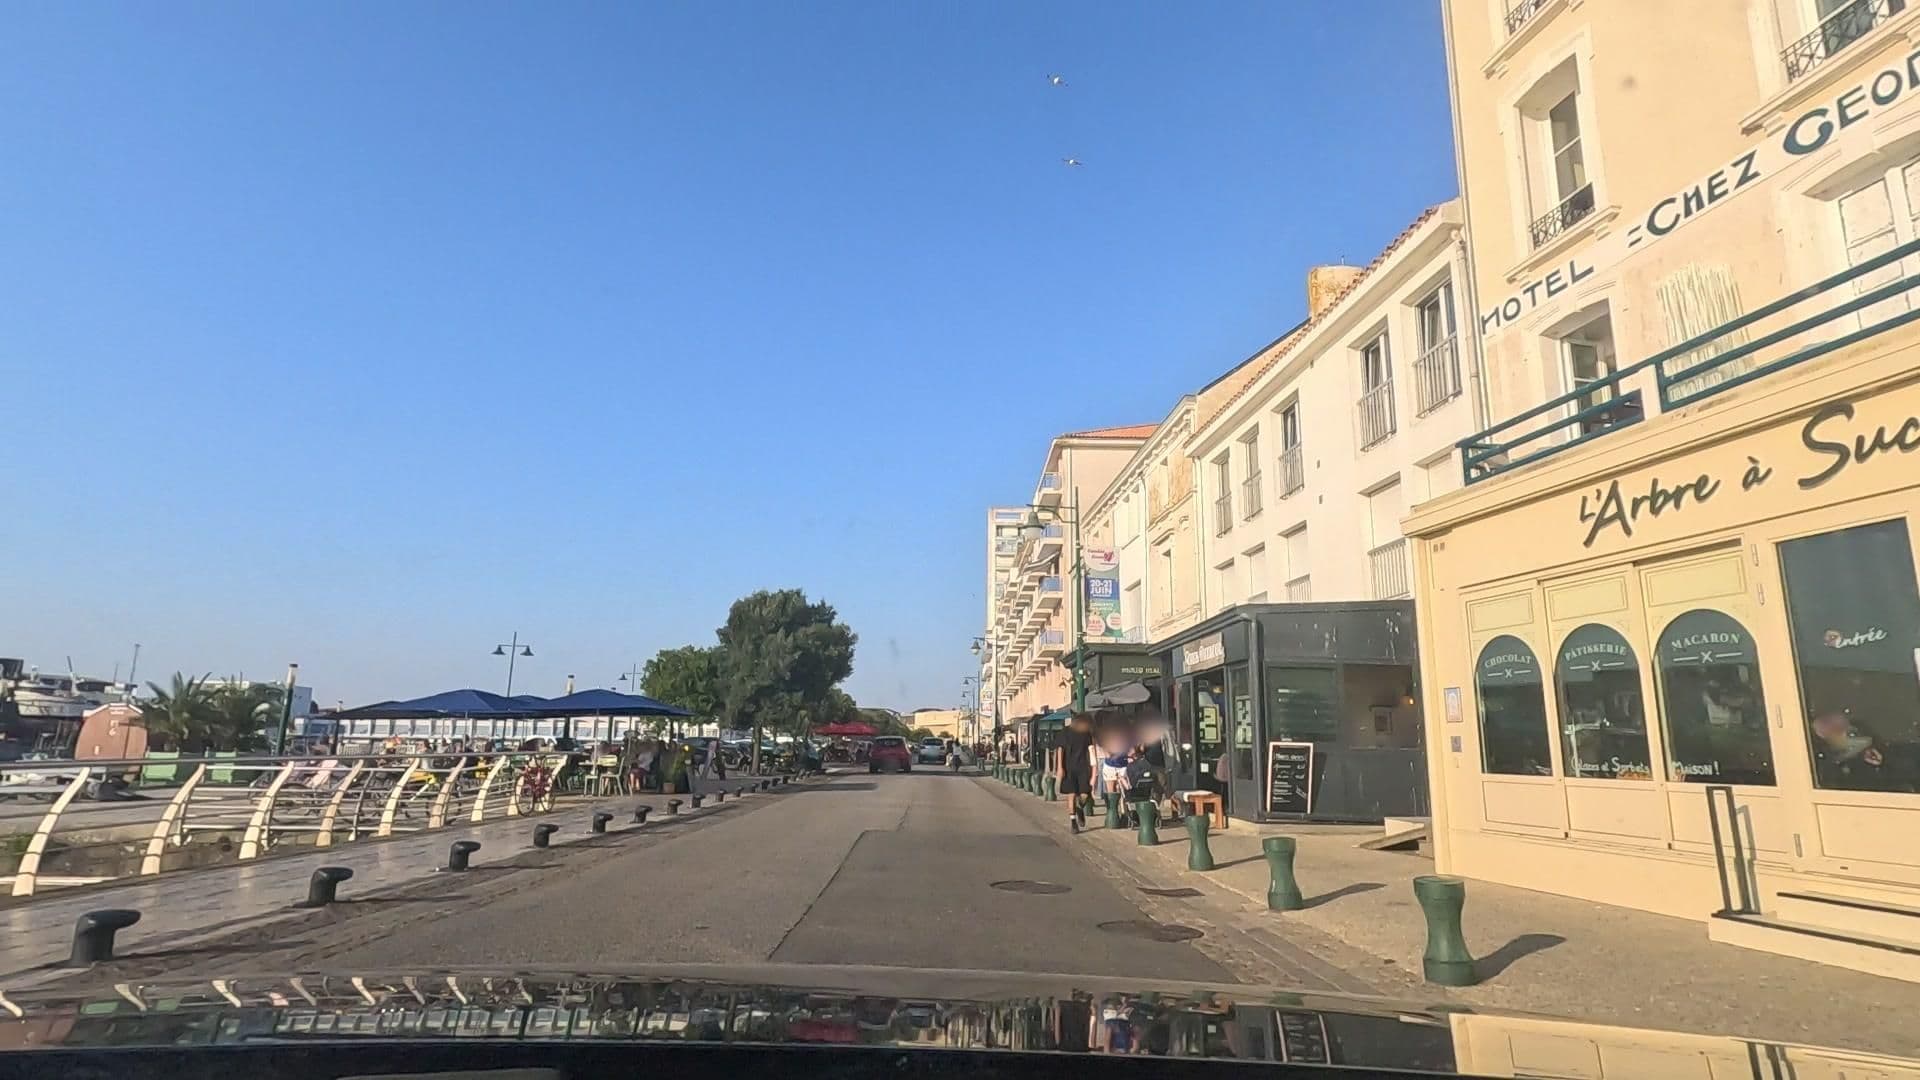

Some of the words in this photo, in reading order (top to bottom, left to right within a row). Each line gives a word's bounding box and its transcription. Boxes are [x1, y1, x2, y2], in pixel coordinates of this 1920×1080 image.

[1481, 260, 1594, 335] HOTEL
[1580, 474, 1721, 548] L'Arbre
[1742, 455, 1772, 491] à
[1484, 654, 1532, 669] CHOCOLAT
[1671, 632, 1741, 651] MACARON
